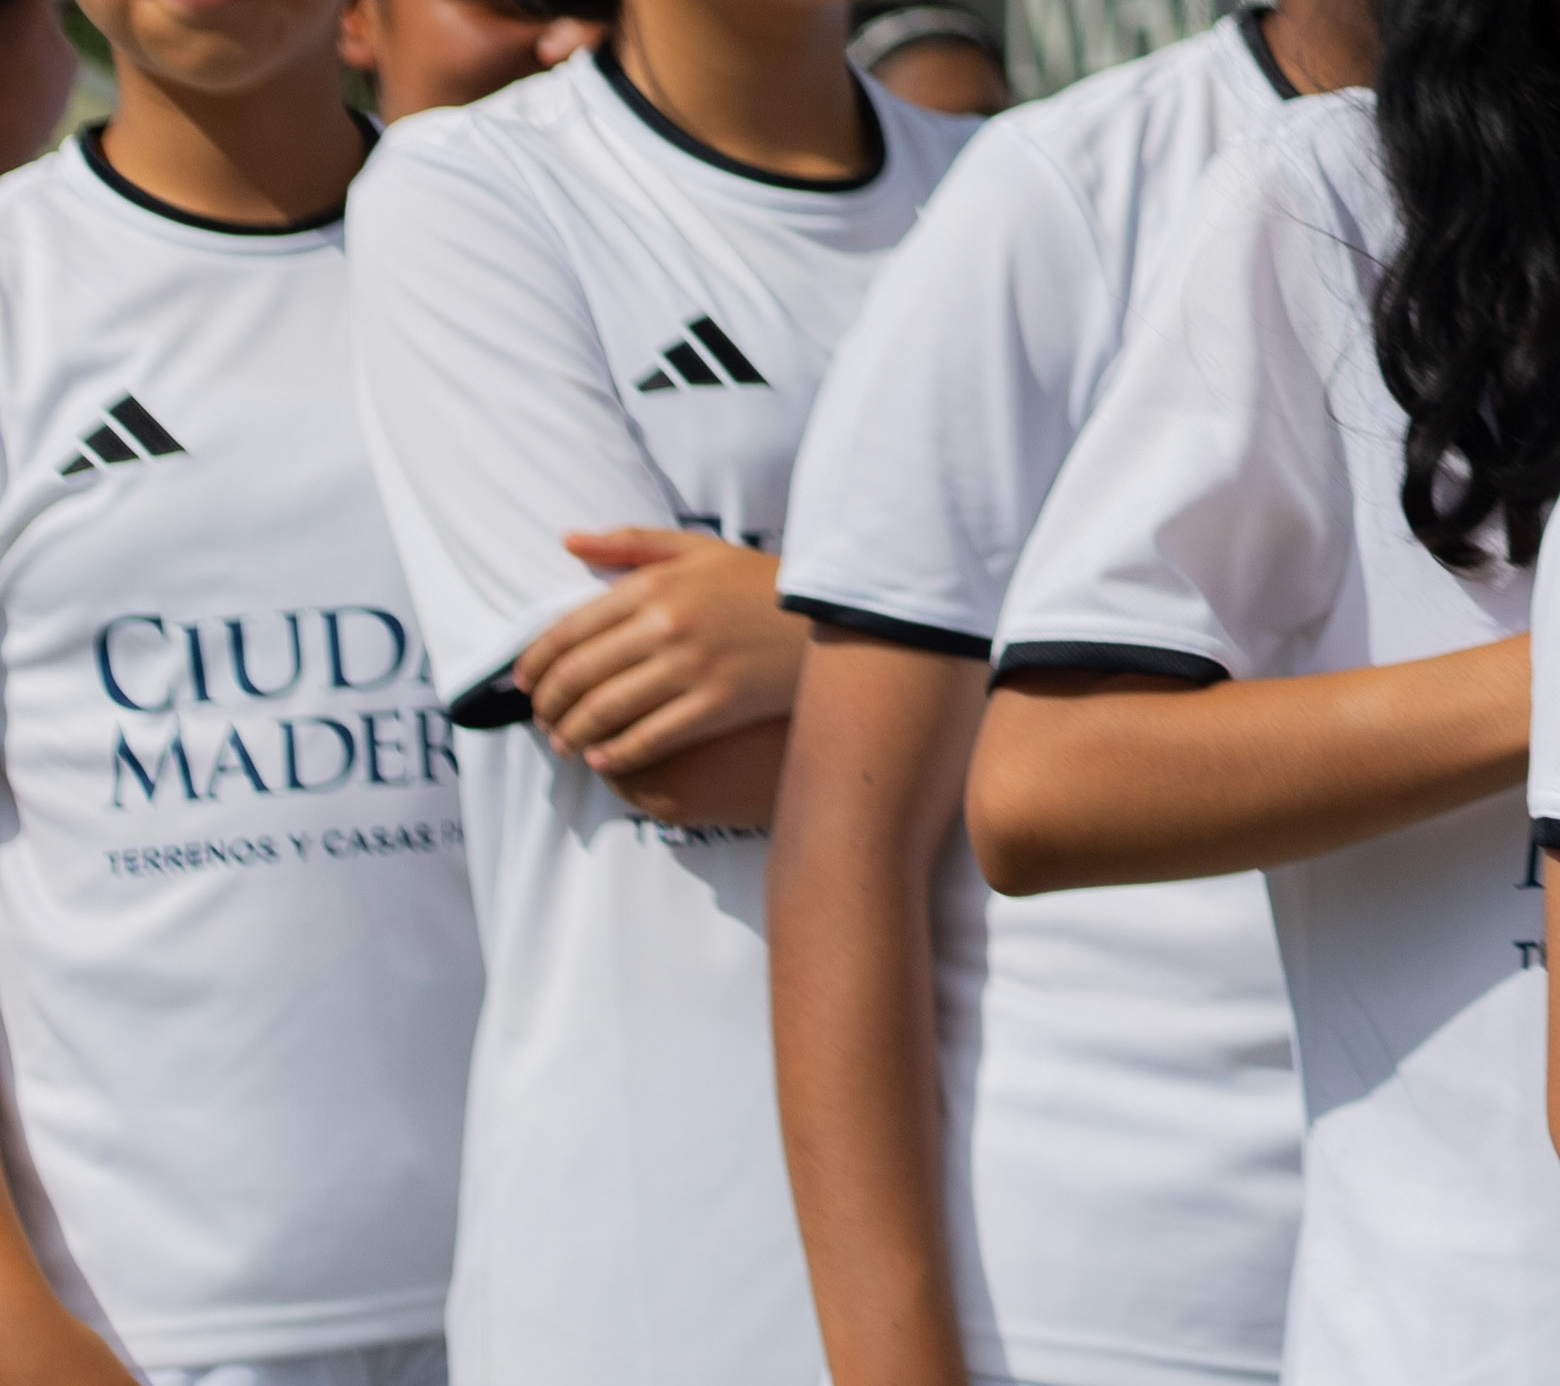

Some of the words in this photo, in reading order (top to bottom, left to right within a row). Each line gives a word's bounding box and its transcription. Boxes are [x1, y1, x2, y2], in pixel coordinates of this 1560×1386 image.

[93, 605, 434, 712] CIUD
[105, 835, 278, 876] TERRENOS
[288, 831, 313, 860] Y
